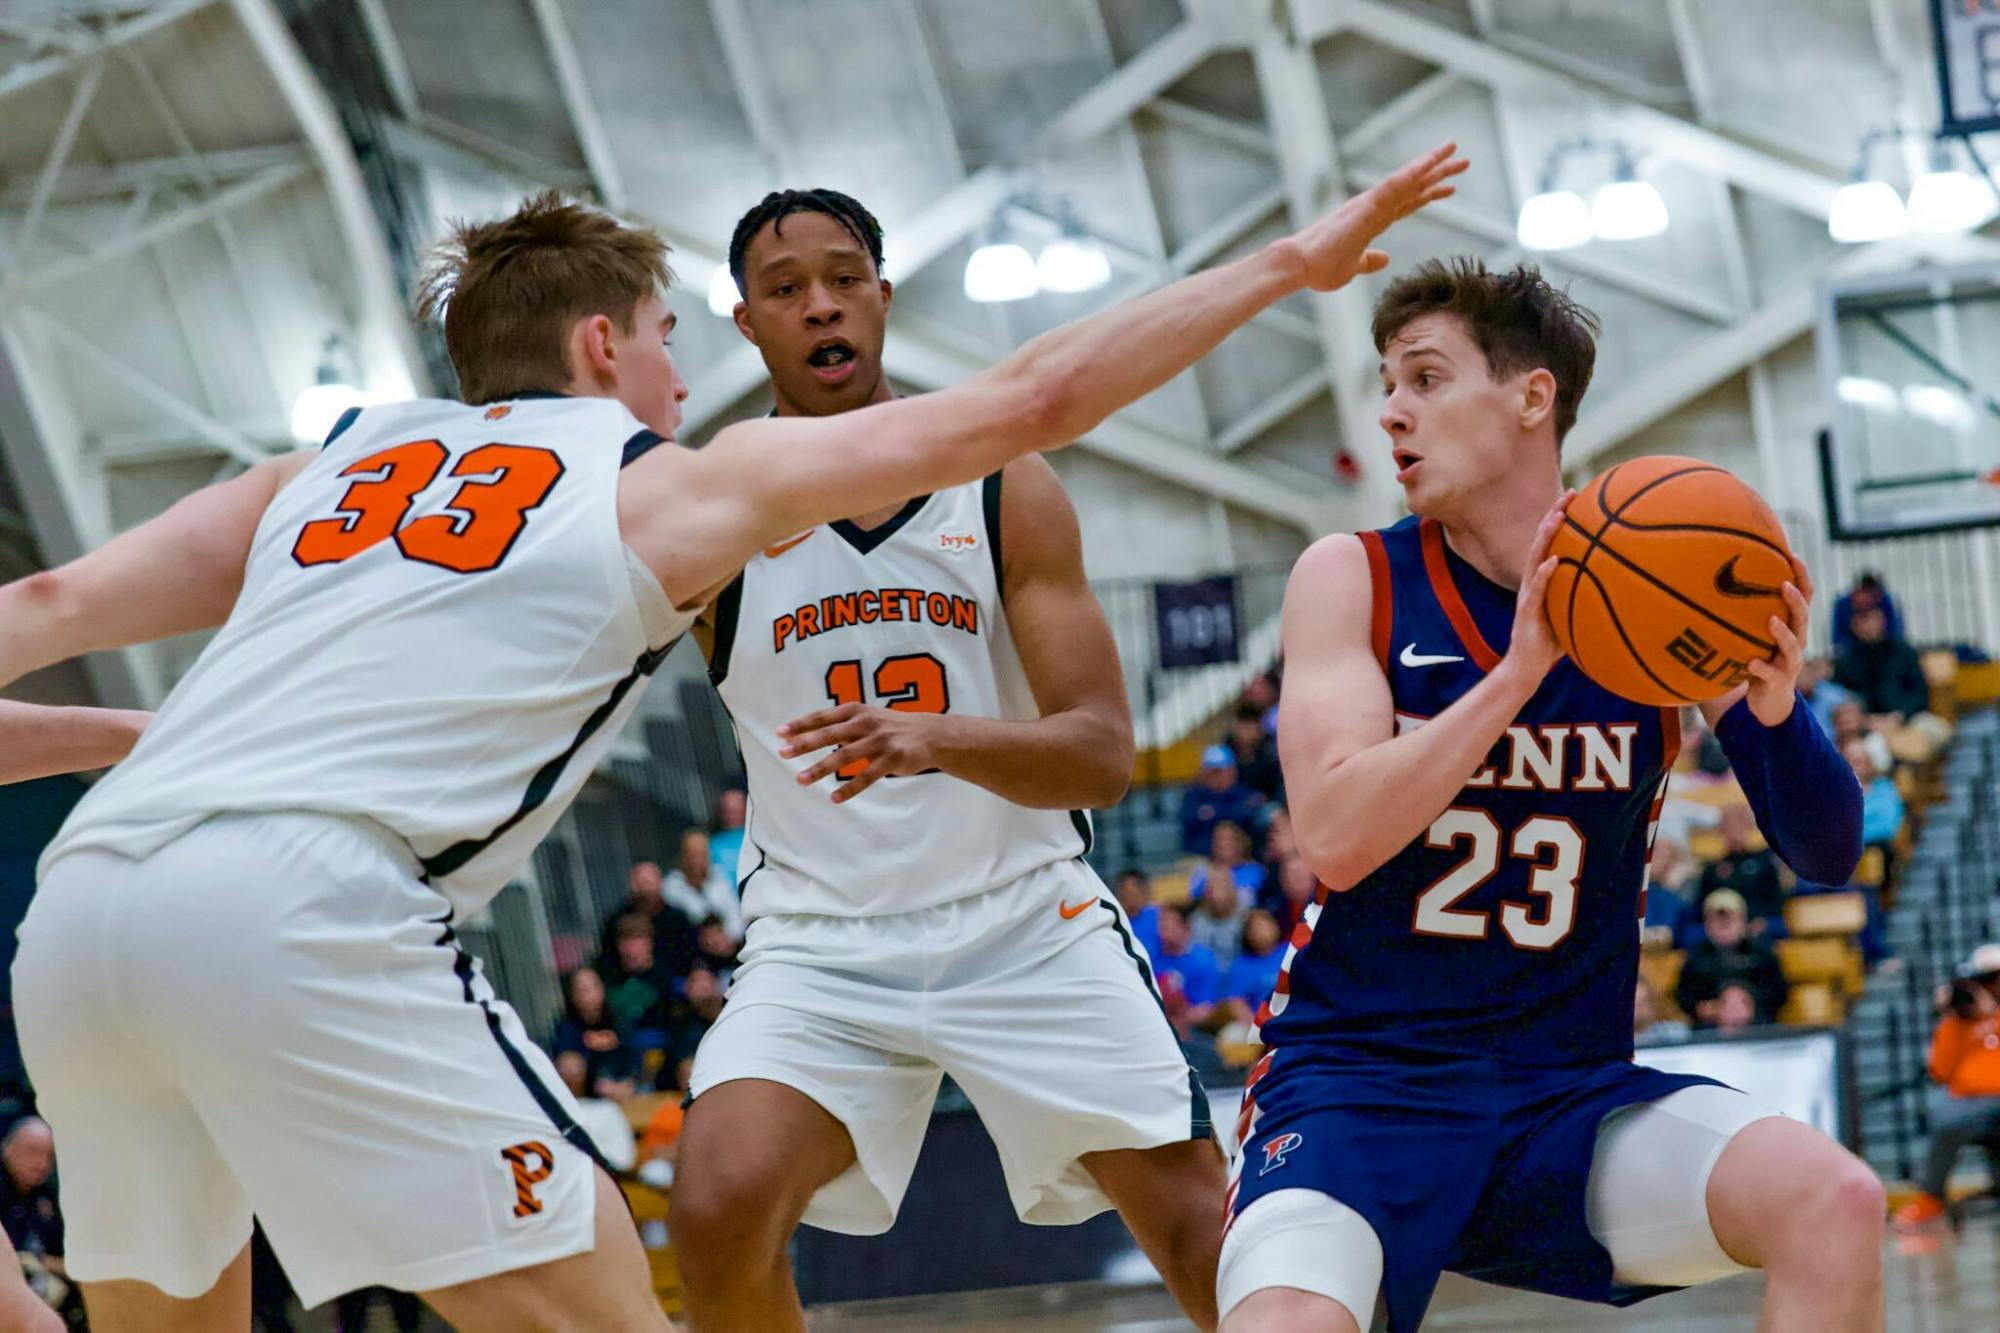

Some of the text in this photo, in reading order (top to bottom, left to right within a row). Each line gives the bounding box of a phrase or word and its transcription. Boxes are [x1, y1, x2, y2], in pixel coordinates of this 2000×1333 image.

[291, 438, 566, 575] 33
[940, 534, 964, 549] Ivy
[773, 588, 977, 653] PRINCETON
[1393, 708, 1639, 792] NN
[1411, 805, 1587, 951] 23
[501, 1140, 555, 1219] P
[1259, 1132, 1303, 1177] P
